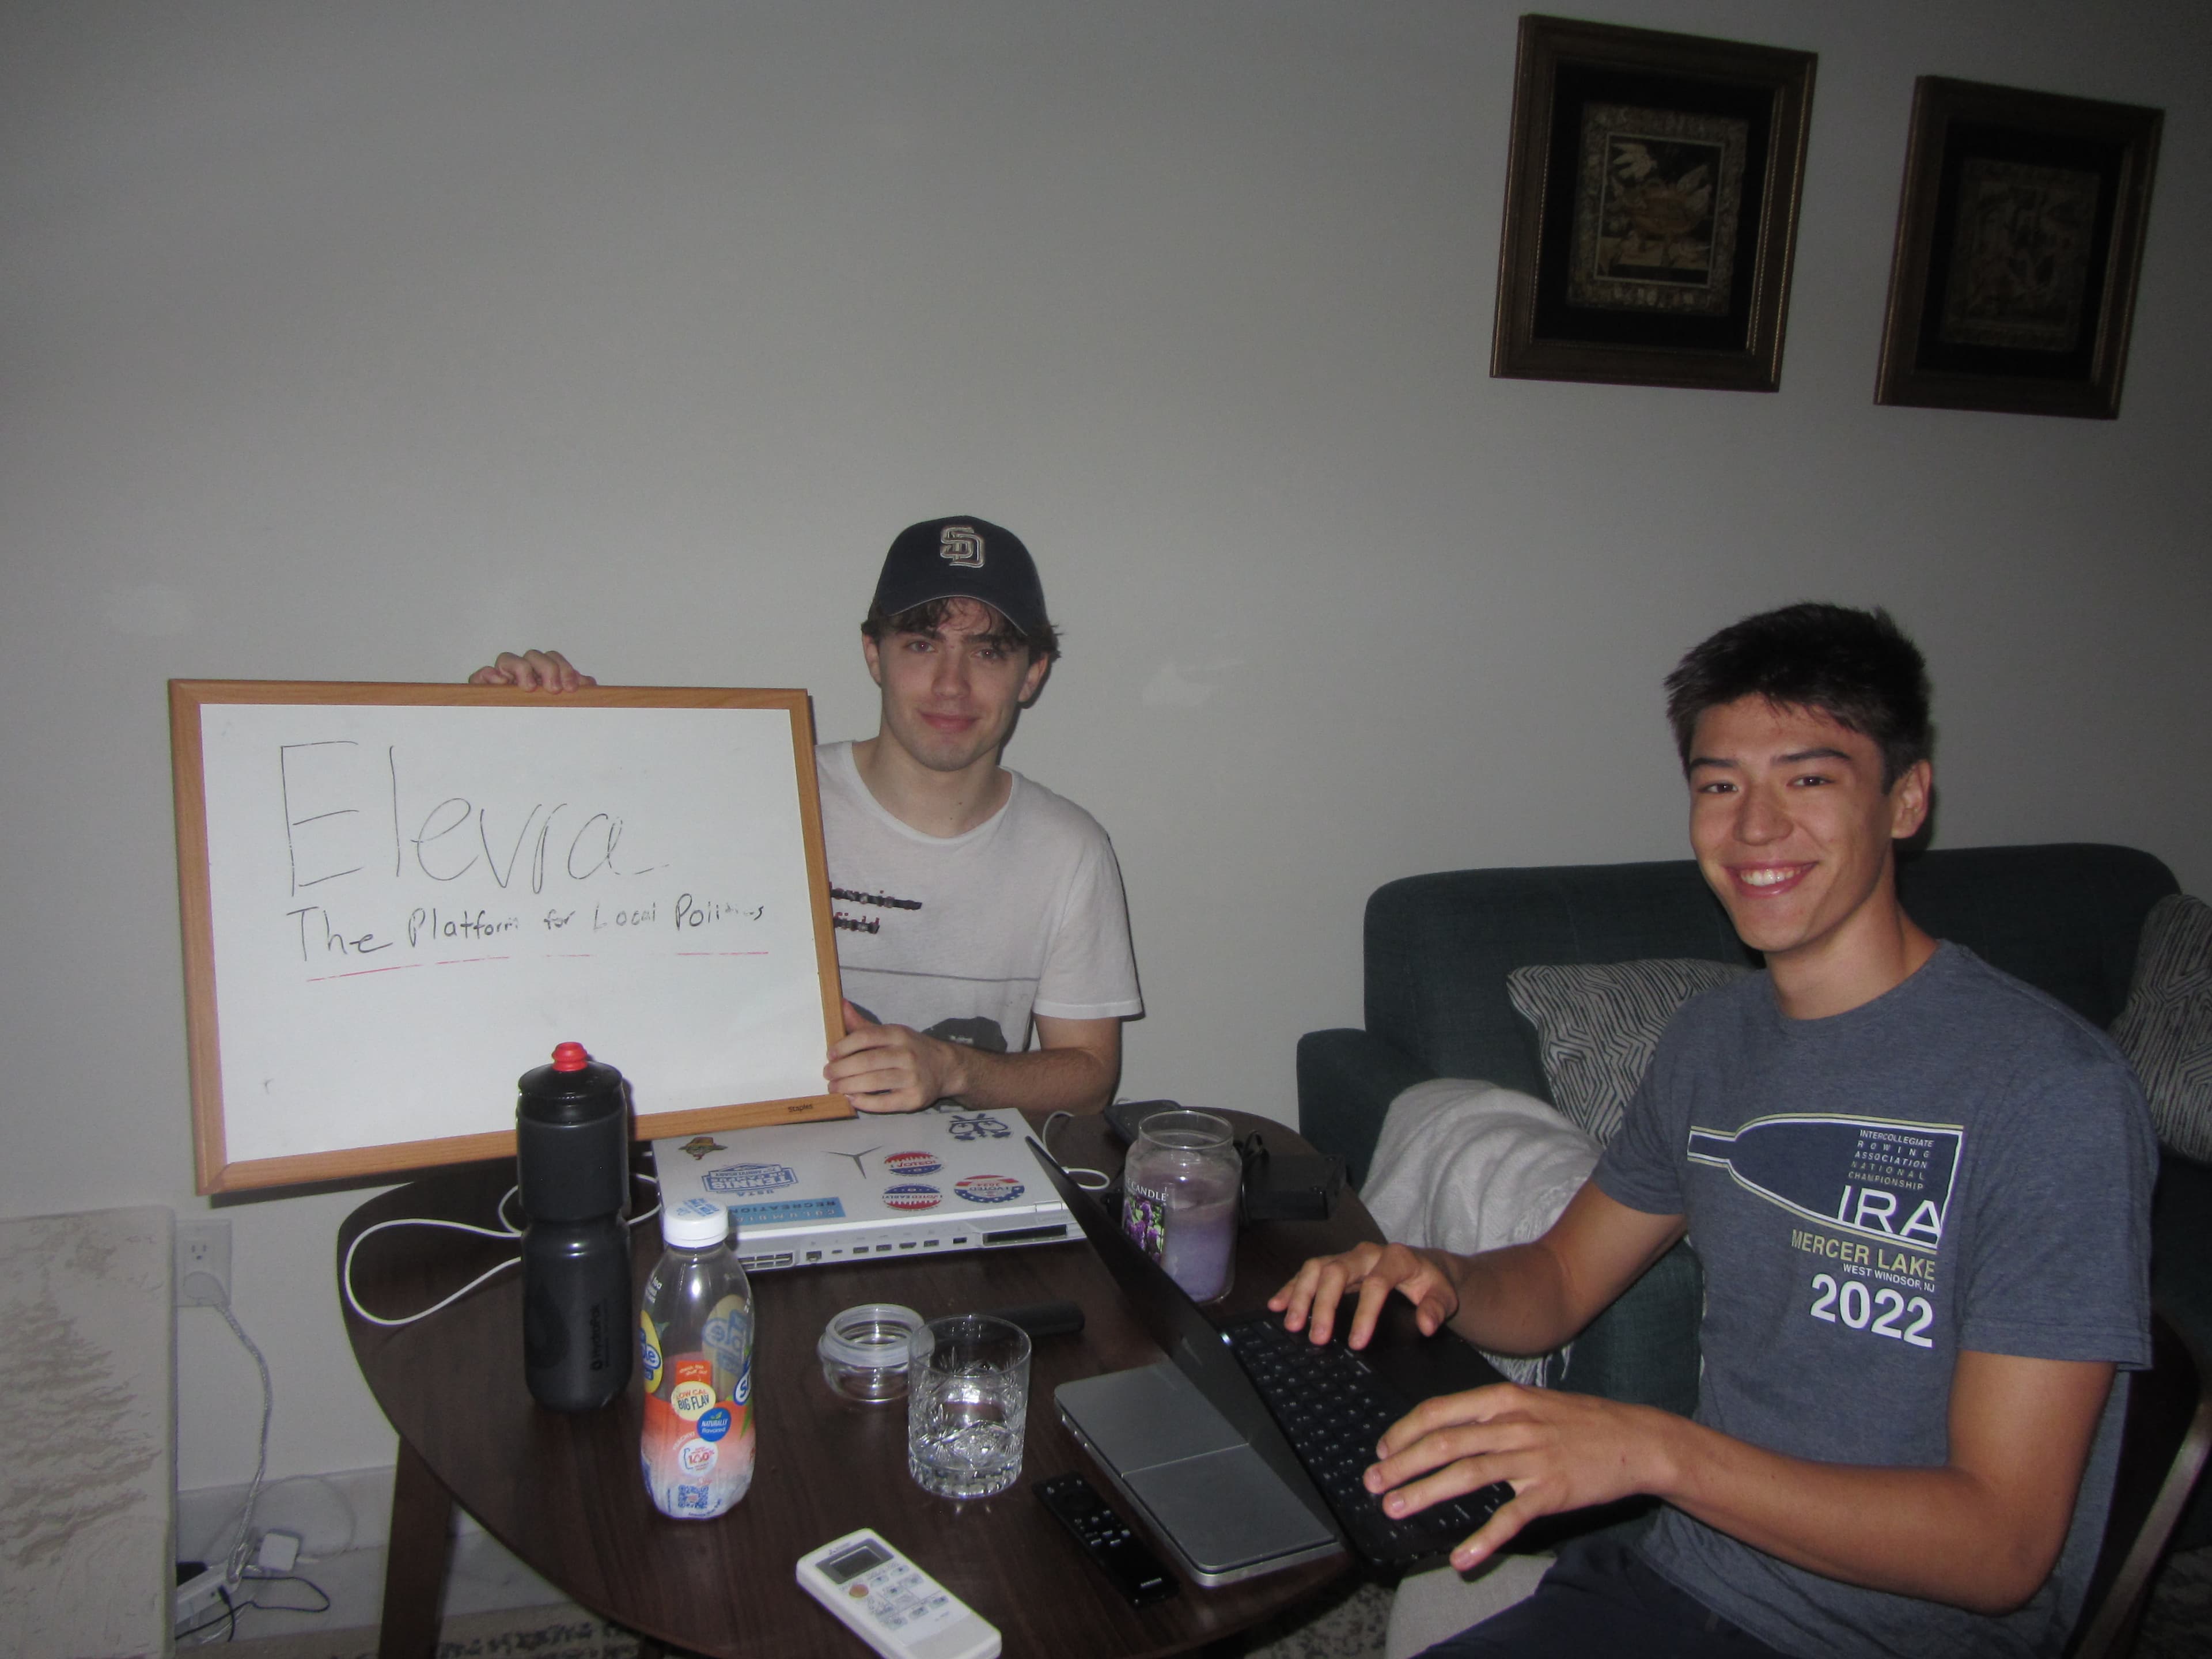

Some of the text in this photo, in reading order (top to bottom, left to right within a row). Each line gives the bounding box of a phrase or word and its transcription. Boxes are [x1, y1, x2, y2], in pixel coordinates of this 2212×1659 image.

[286, 906, 394, 962] The
[543, 908, 577, 930] for
[787, 1103, 813, 1113] Staples
[1859, 1129, 1934, 1147] INTERCOLLEGIATE
[1857, 1140, 1930, 1158] ROWING
[1854, 1151, 1927, 1169] ASSOCIATION
[1851, 1161, 1925, 1180] NATIONAL
[711, 1175, 791, 1190] TENNIS
[1848, 1171, 1924, 1191] CHAMPIONSHIP
[1131, 1180, 1167, 1202] CANDLE
[729, 1200, 835, 1214] RECREATION
[736, 1209, 835, 1222] COLUMBIA
[1837, 1184, 1942, 1243] IRA
[1791, 1229, 1936, 1282] MERCER LAKE
[1843, 1263, 1936, 1293] WEST WINDSOR, NJ
[1810, 1273, 1933, 1348] 2022
[692, 1388, 709, 1396] CAL
[677, 1394, 710, 1411] BIG FLAV
[701, 1418, 729, 1427] NATURALLY
